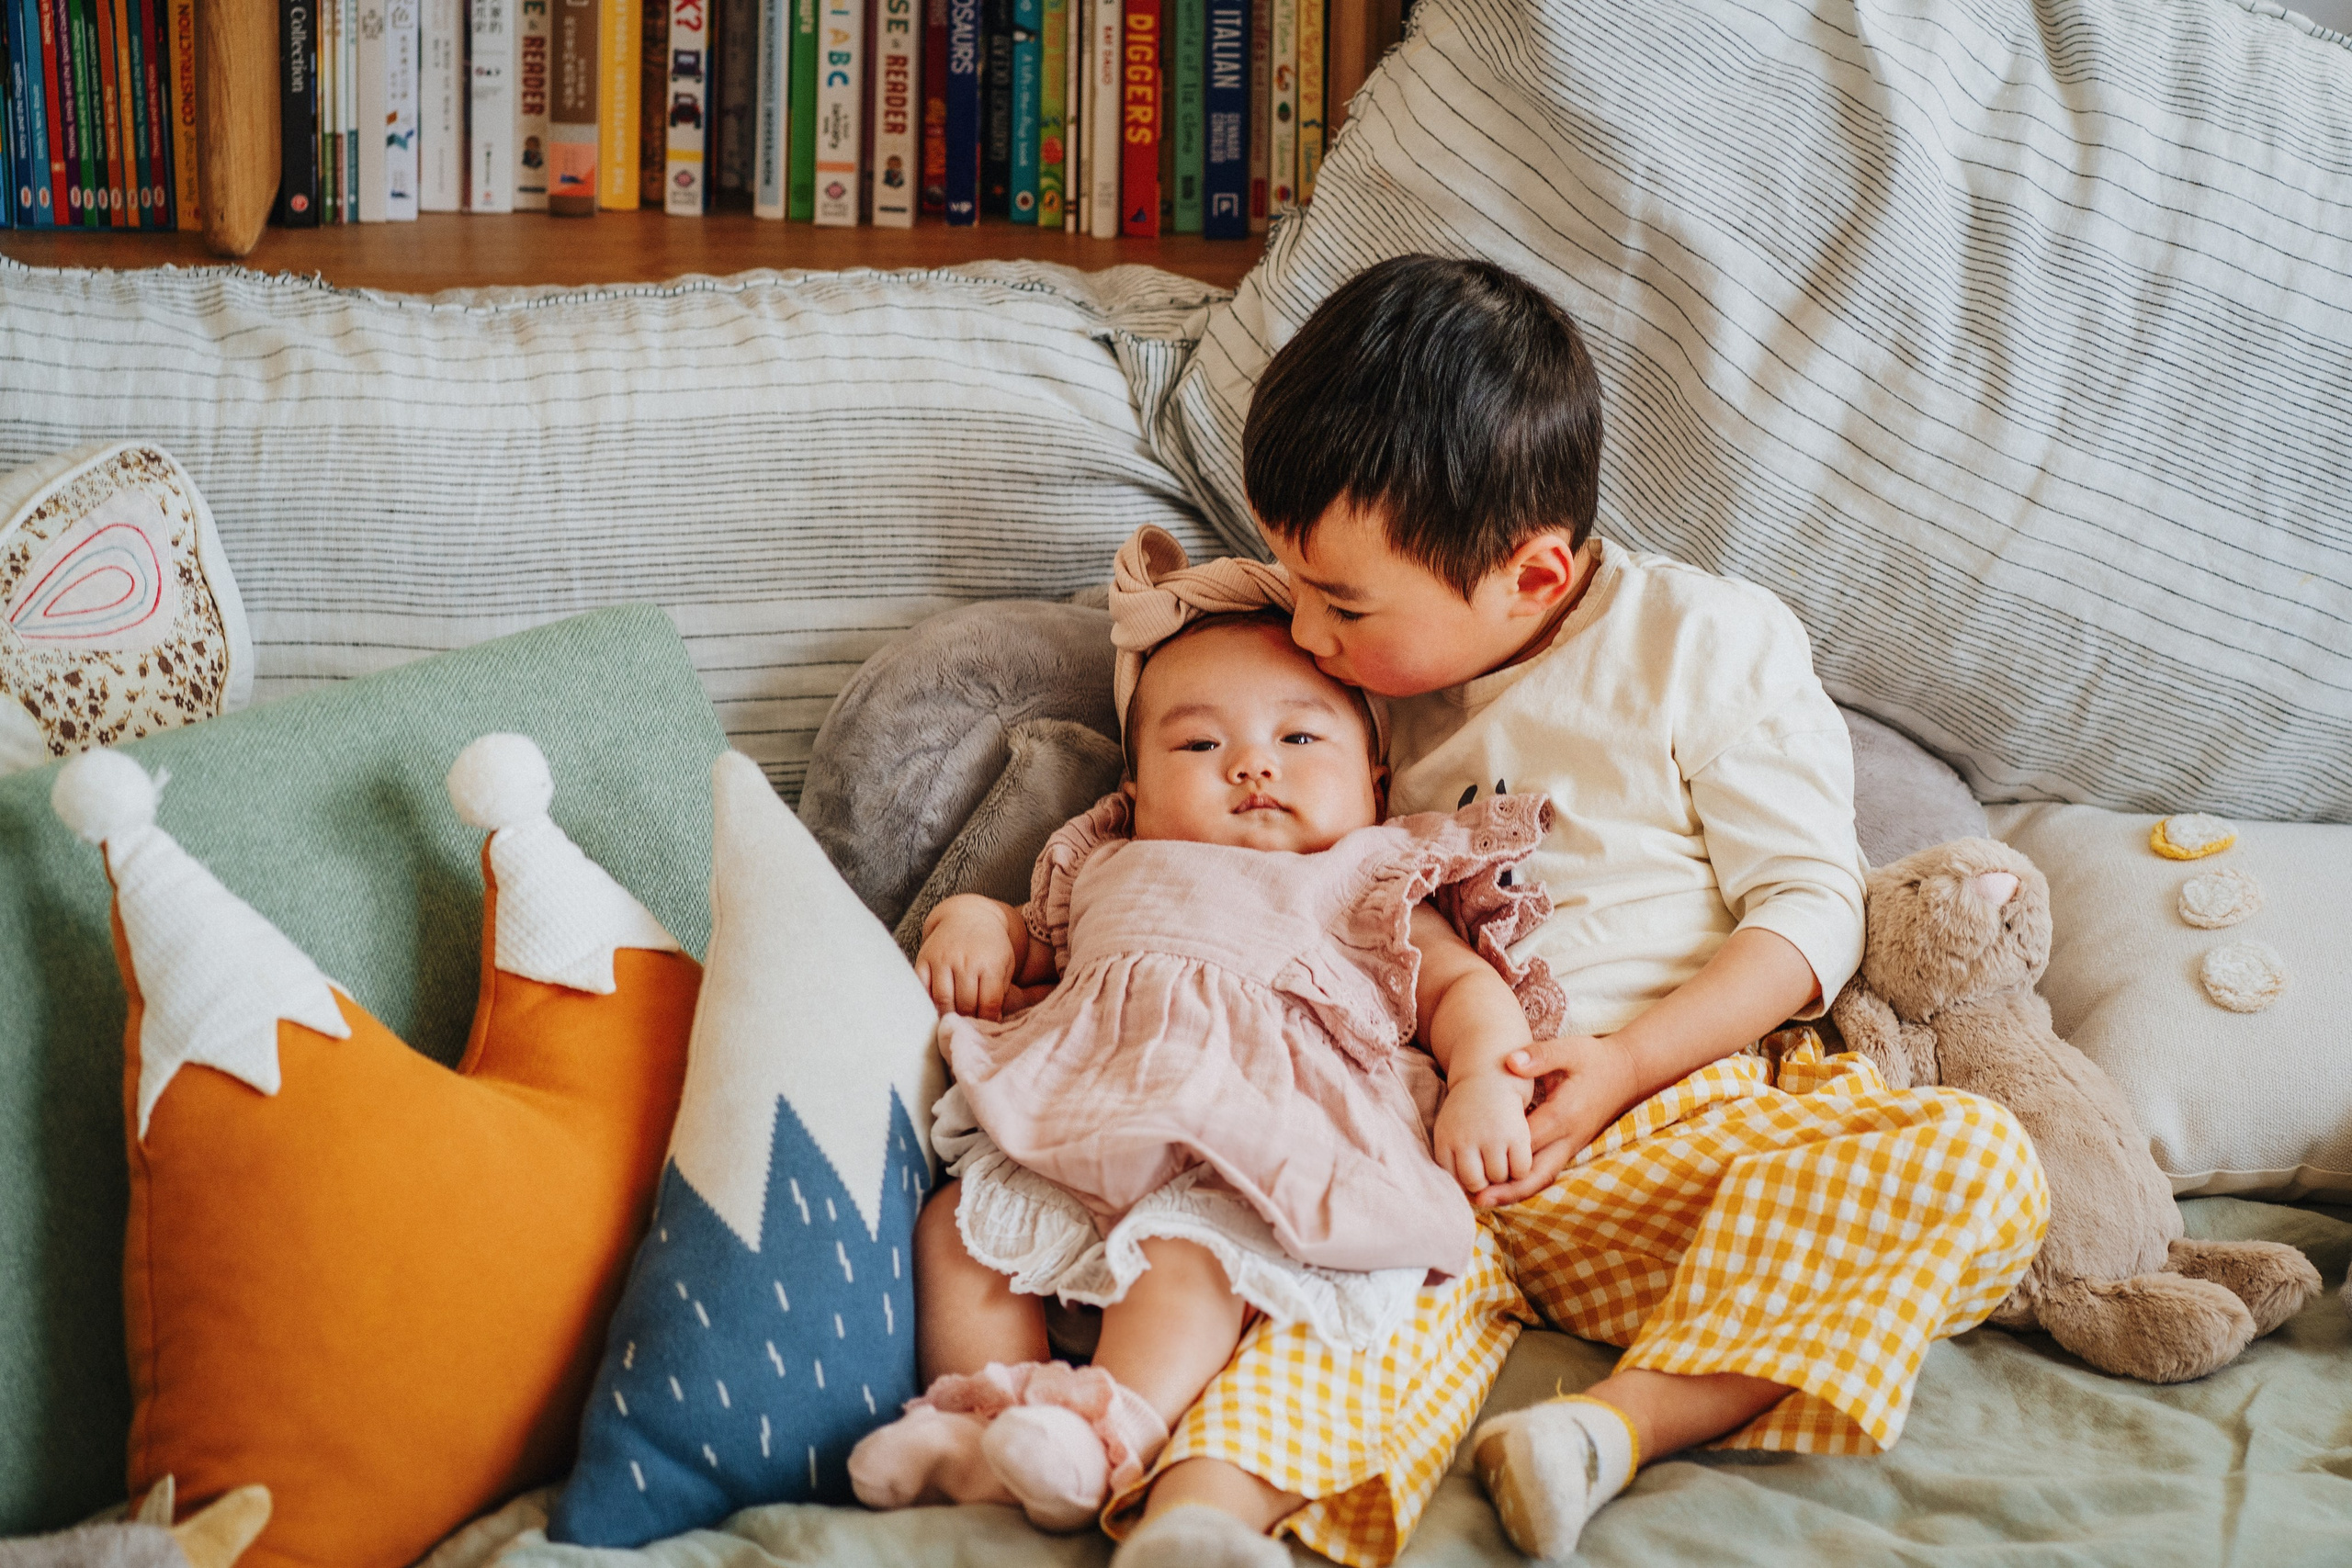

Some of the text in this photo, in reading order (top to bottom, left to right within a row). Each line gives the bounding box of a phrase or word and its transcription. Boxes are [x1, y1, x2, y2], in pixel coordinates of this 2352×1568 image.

[178, 4, 195, 126] CONSTRUCTION
[290, 6, 307, 93] Collection
[523, 36, 546, 116] READER
[828, 28, 852, 87] ABC
[1125, 14, 1155, 144] DIGGERS
[1212, 9, 1242, 88] ITALIAN
[885, 55, 908, 134] READER
